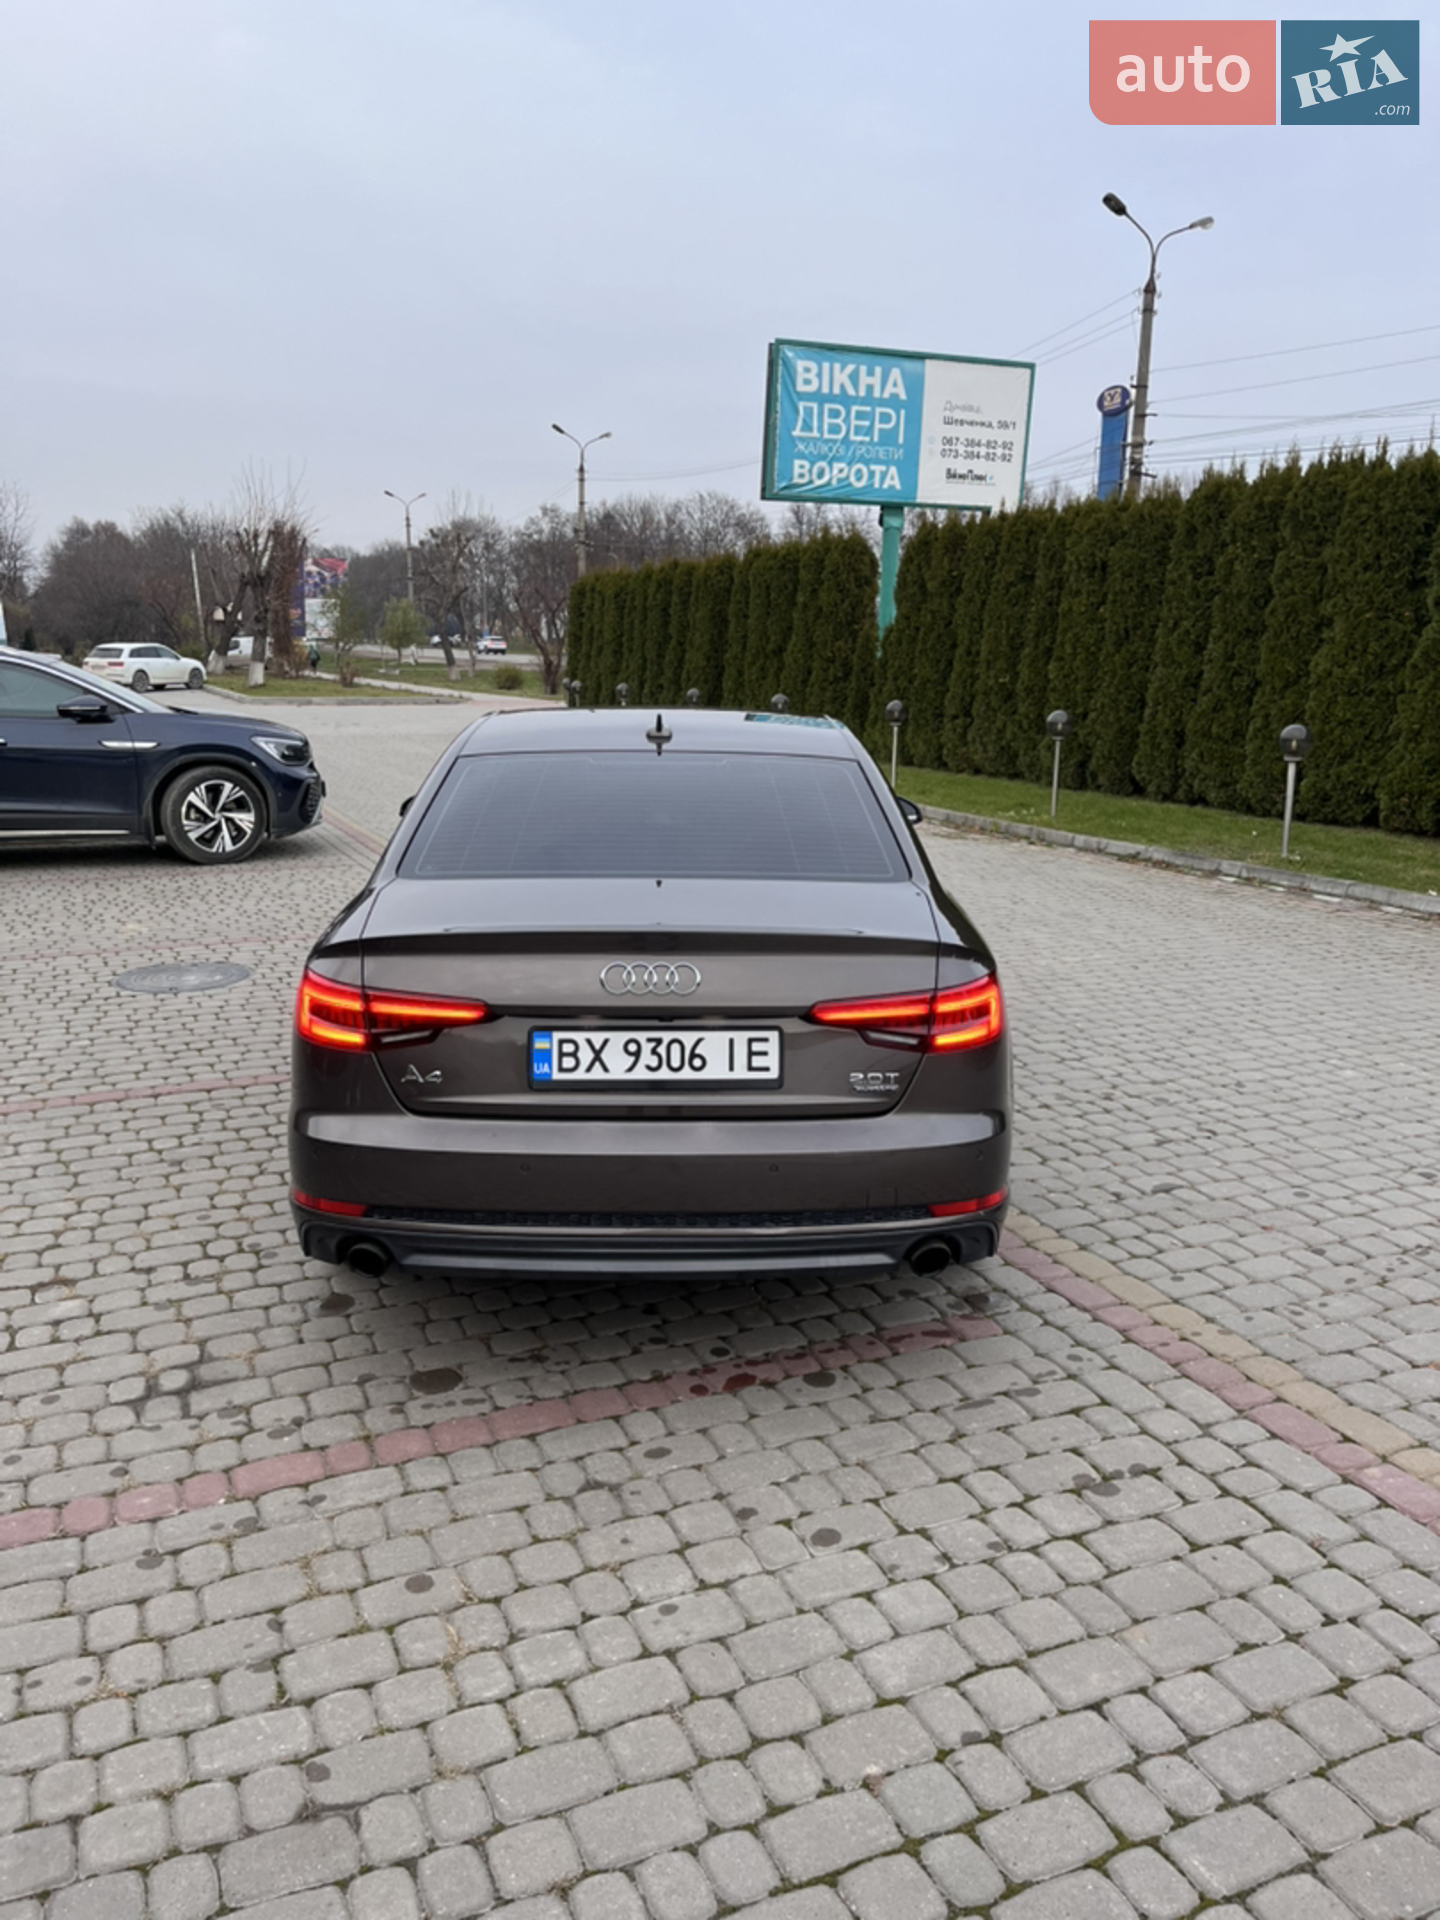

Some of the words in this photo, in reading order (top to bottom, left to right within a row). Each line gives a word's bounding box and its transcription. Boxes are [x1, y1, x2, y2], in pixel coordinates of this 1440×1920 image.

[795, 359, 908, 401] ВІКНА
[791, 400, 906, 445] ДВЕРІ
[792, 458, 902, 491] ВОРОТА
[533, 1062, 550, 1074] UA
[557, 1037, 611, 1074] BX
[622, 1037, 708, 1074] 9306
[401, 1063, 443, 1084] A4
